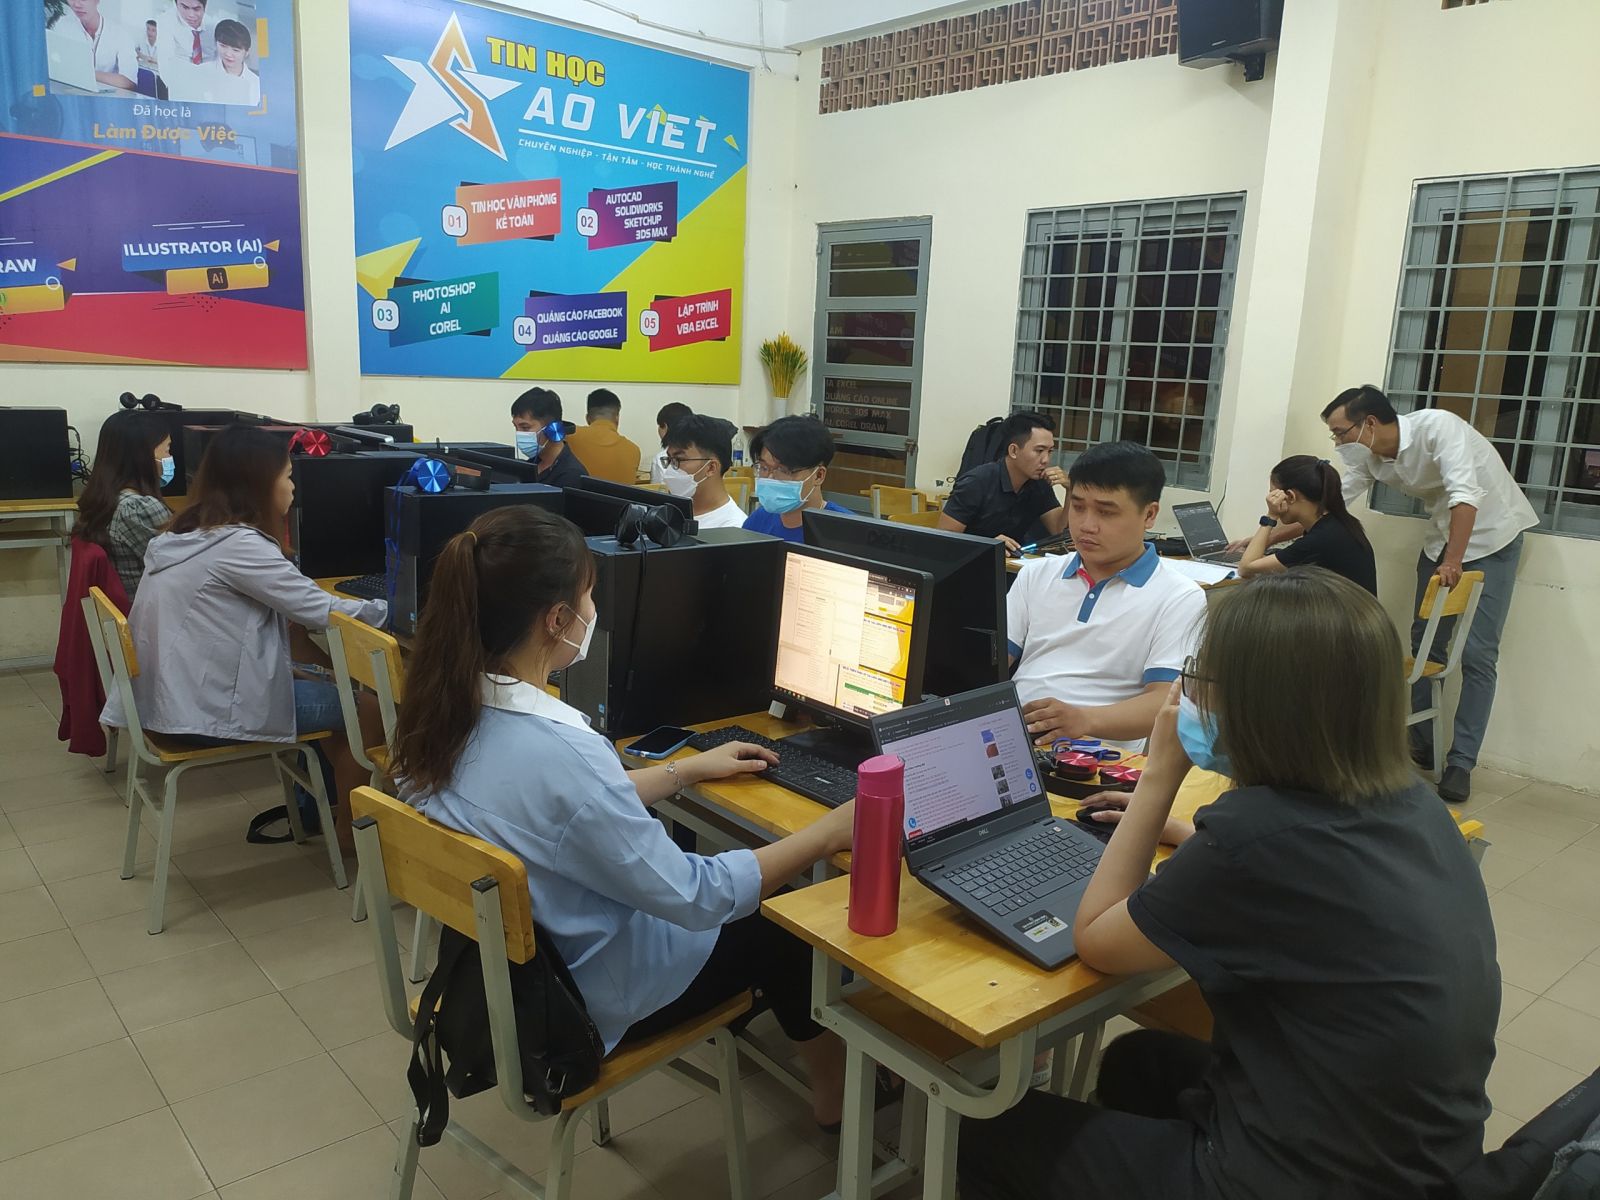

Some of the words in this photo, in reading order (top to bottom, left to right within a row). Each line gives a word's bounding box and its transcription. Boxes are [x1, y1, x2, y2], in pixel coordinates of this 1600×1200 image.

[486, 37, 537, 74] TIN
[546, 50, 606, 87] HỌC
[133, 104, 151, 117] Đã
[154, 105, 178, 119] học
[180, 107, 192, 118] là
[523, 86, 596, 132] AO
[94, 123, 136, 139] Làm
[141, 124, 192, 144] Được
[196, 126, 238, 144] Việc
[518, 139, 557, 152] CHUYÊN
[471, 201, 487, 214] TIN
[487, 198, 506, 213] HỌC
[527, 192, 557, 207] PHÒNG
[606, 191, 642, 205] AUTOCAD
[615, 201, 663, 217] SOLIDWORKS
[448, 214, 462, 229] 01
[509, 212, 534, 227] TOÁN
[581, 215, 594, 229] 02
[624, 214, 662, 229] SKETCHUP
[635, 229, 651, 240] 3DS
[651, 226, 668, 238] MAX
[123, 240, 233, 257] ILLUSTRATOR
[236, 238, 263, 254] (AI)
[212, 272, 224, 285] Ai
[412, 281, 477, 303] PHOTOSHOP
[377, 308, 393, 322] 03
[440, 301, 451, 315] AI
[583, 307, 623, 320] FACEBOOK
[430, 319, 462, 336] COREL
[518, 324, 532, 337] 04
[644, 317, 656, 329] 05
[676, 321, 695, 336] VBA
[695, 317, 719, 332] EXCEL
[588, 328, 618, 341] GOOGLE
